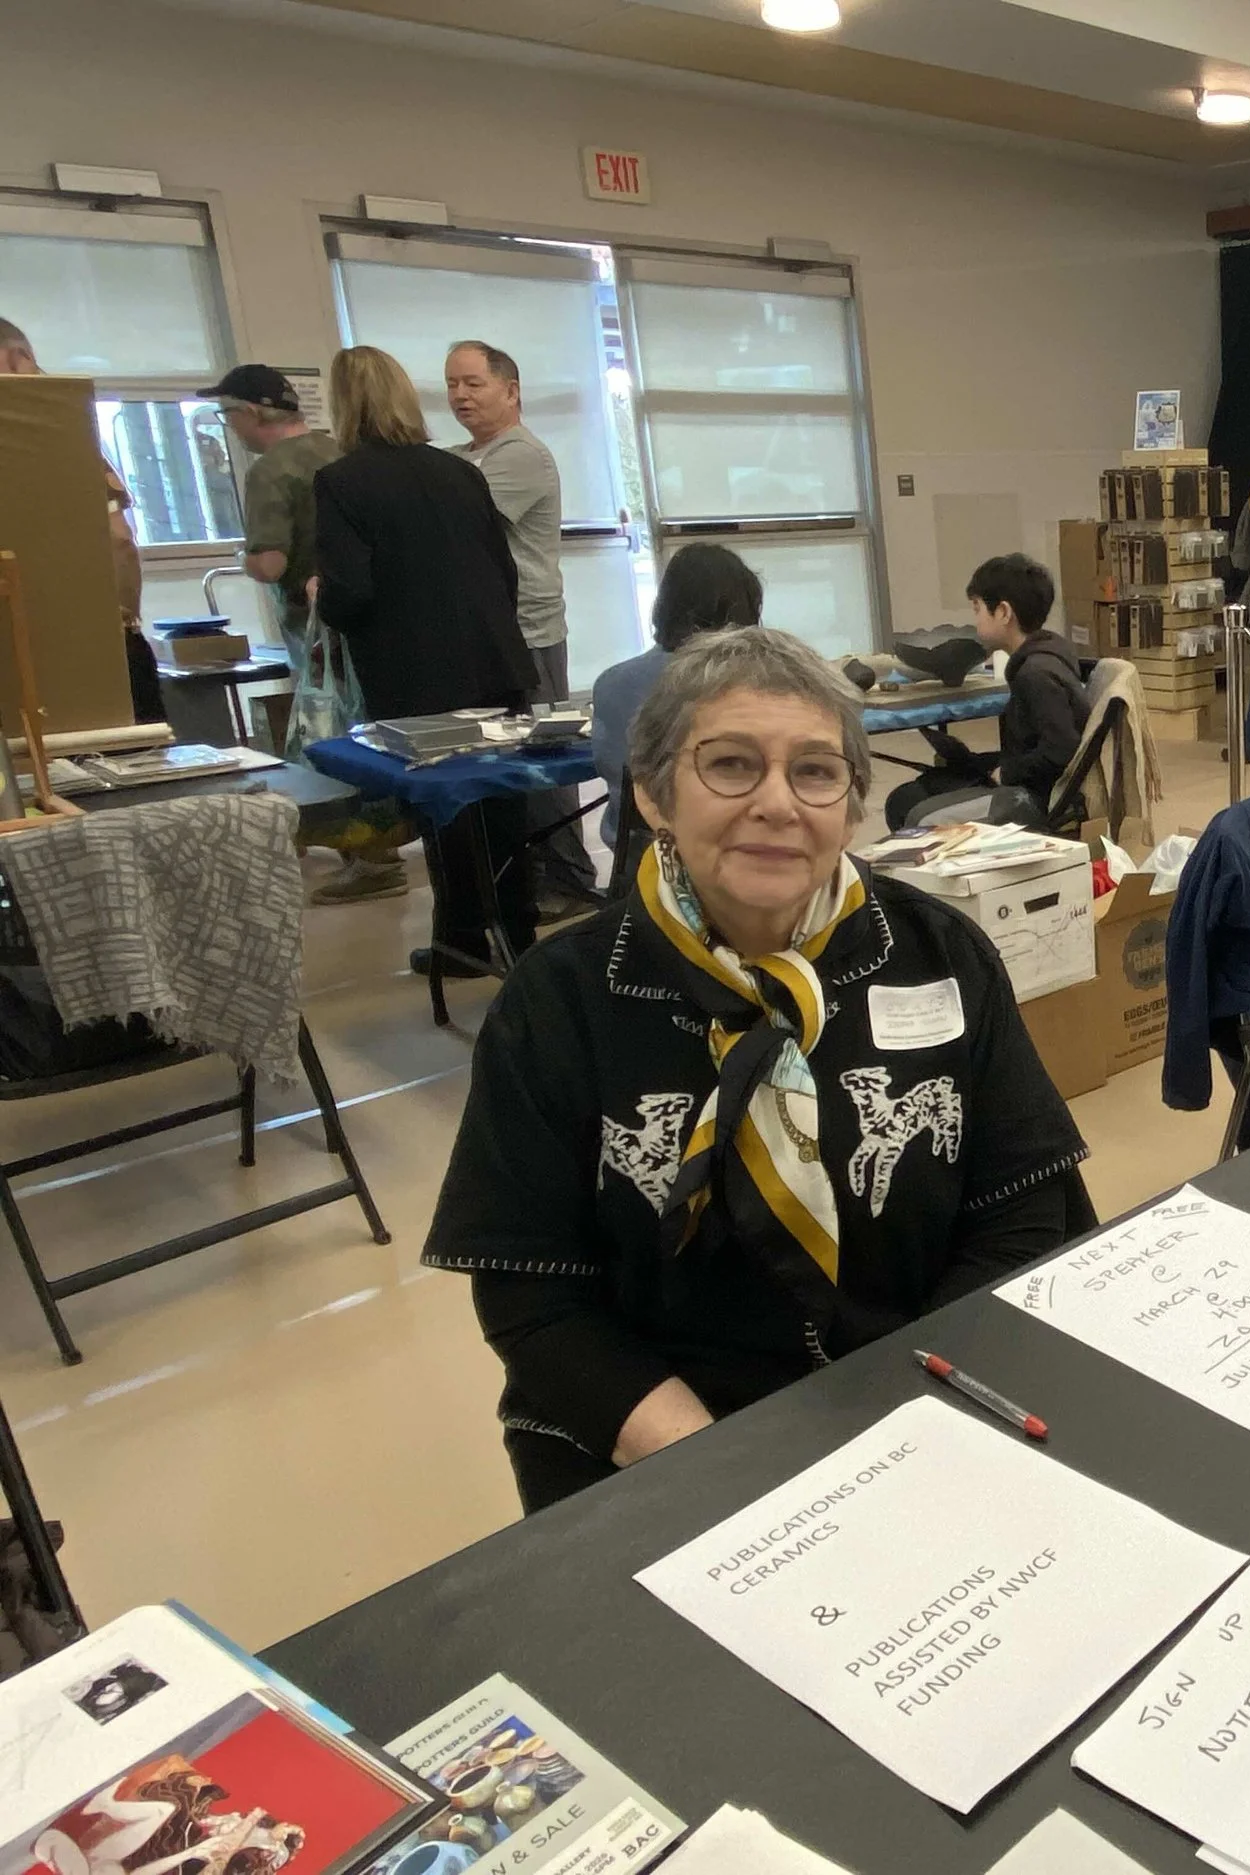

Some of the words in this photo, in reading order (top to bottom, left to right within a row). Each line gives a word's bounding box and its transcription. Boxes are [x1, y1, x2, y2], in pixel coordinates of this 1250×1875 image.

[596, 153, 639, 194] EXIT
[1068, 1228, 1137, 1270] NEXT
[1083, 1230, 1199, 1291] SPEAKER
[1151, 1264, 1182, 1284] @
[1024, 1275, 1044, 1310] FREE
[1132, 1286, 1201, 1327] MARCH
[1203, 1259, 1239, 1280] 29
[1206, 1292, 1229, 1307] @
[706, 1483, 856, 1581] PUBLICATIONS
[855, 1460, 890, 1485] ON
[887, 1441, 918, 1463] BC
[729, 1521, 840, 1596] CERAMICS
[810, 1604, 847, 1627] &
[844, 1565, 996, 1678] PUBLICATIONS
[873, 1619, 972, 1698] ASSISTED
[969, 1595, 1000, 1621] BY
[997, 1547, 1059, 1598] NWCF
[896, 1632, 1002, 1717] FUNDING
[1138, 1671, 1197, 1730] SIGN
[1218, 1612, 1244, 1642] UP
[413, 1733, 468, 1773] POTTERS
[468, 1707, 504, 1738] GUILD
[512, 1850, 529, 1865] &
[530, 1803, 586, 1849] SALE
[621, 1823, 660, 1858] BAC
